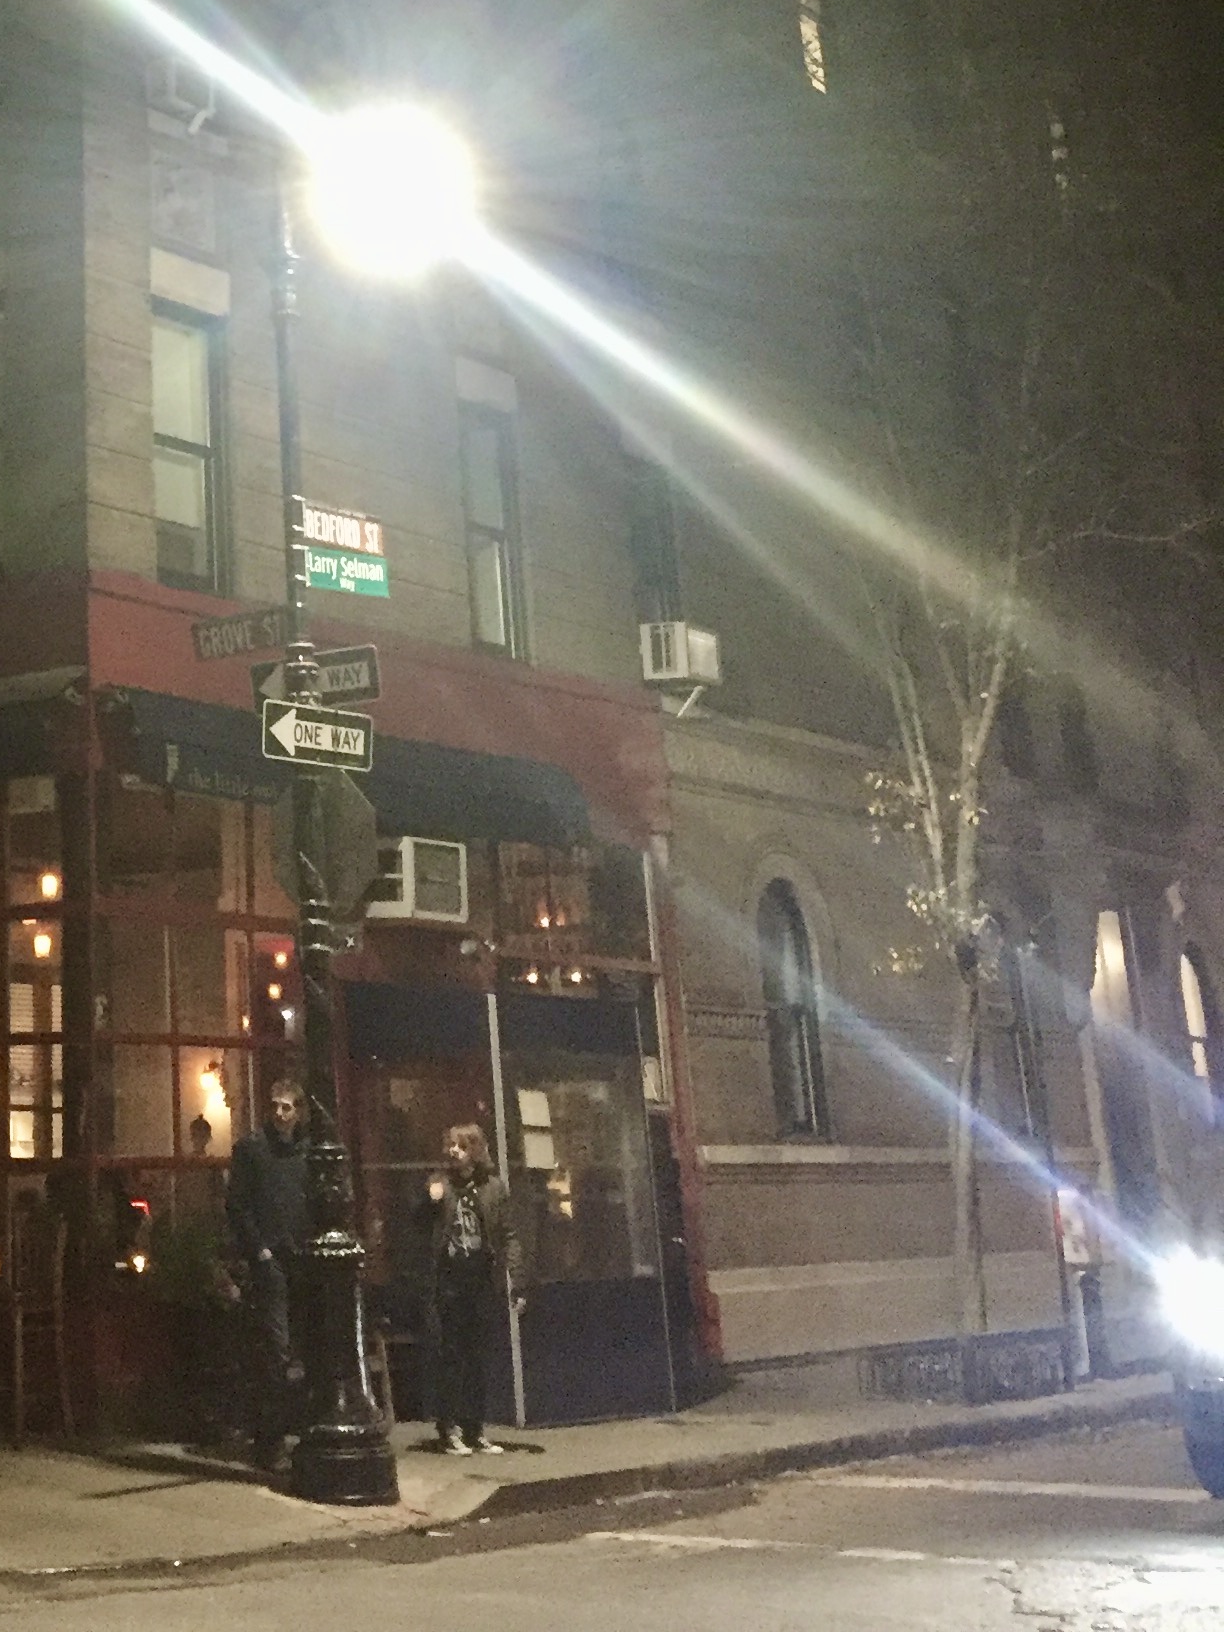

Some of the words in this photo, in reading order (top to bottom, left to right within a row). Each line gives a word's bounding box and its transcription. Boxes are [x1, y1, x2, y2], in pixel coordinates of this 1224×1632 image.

[305, 509, 360, 549] BEDFORD
[364, 522, 379, 552] ST
[309, 552, 338, 580] Larry
[340, 556, 384, 582] Selman
[340, 578, 356, 592] Way
[199, 620, 254, 658] GROVE
[262, 613, 281, 646] ST
[326, 661, 362, 687] WAY
[293, 723, 322, 746] ONE
[330, 727, 361, 751] WAY
